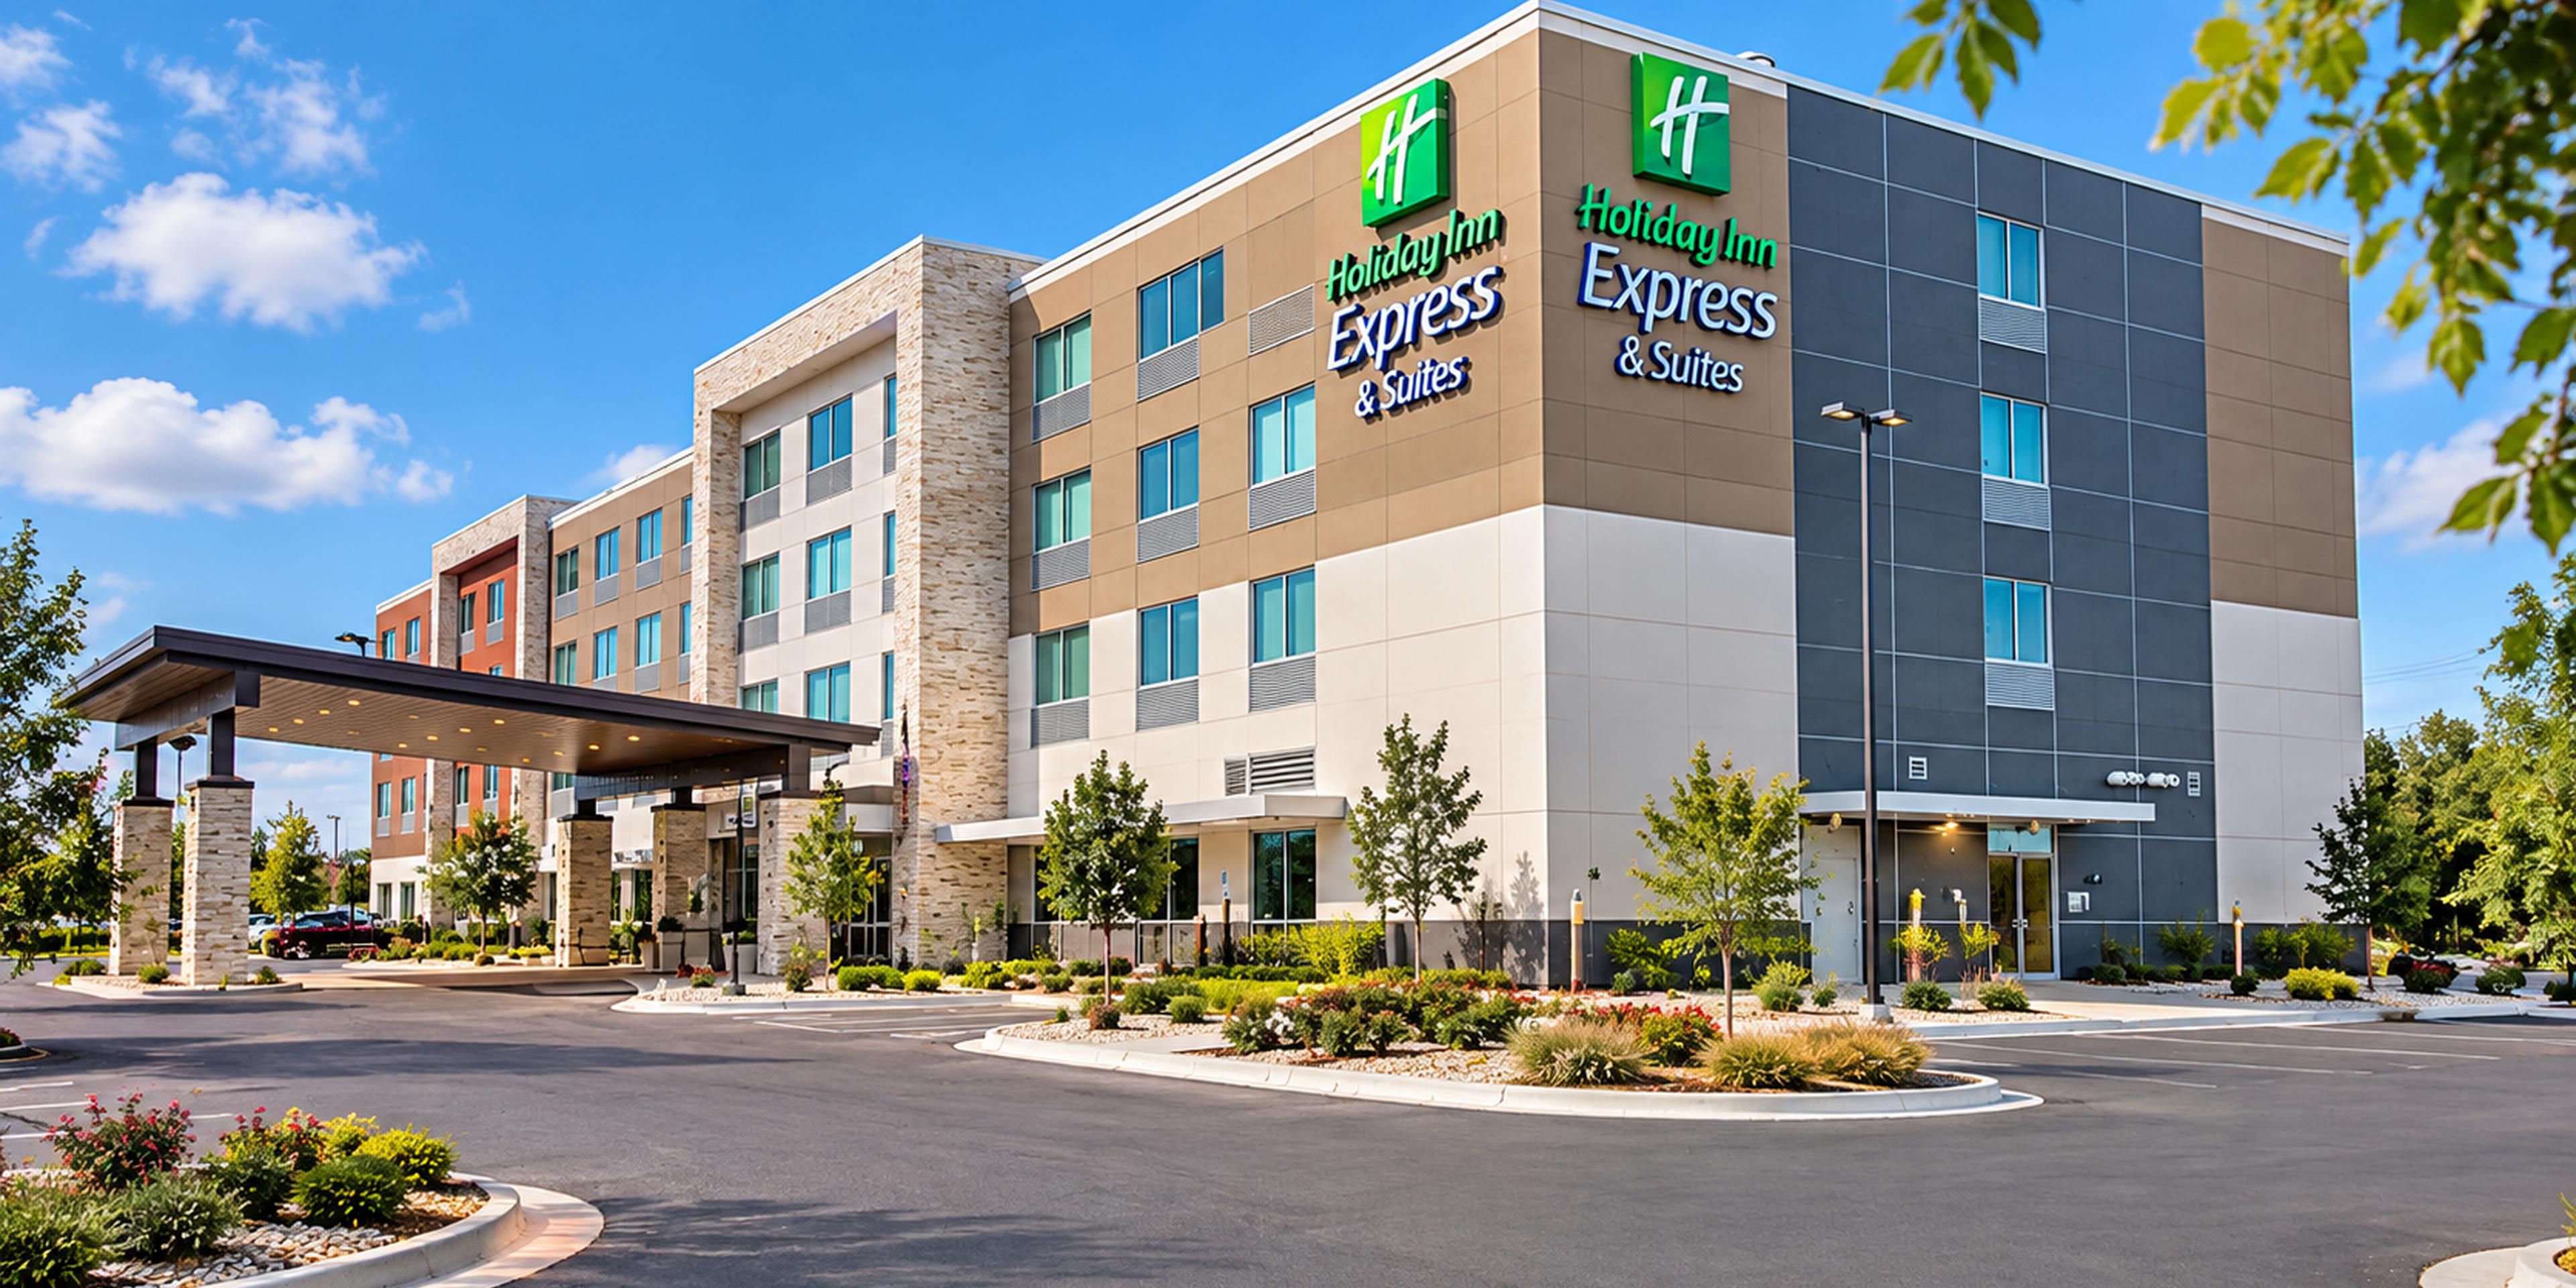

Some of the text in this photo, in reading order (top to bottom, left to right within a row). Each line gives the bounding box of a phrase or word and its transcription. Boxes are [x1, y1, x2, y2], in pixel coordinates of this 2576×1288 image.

[1327, 209, 1501, 302] Holiday Inn
[1578, 182, 1777, 268] Holiday Inn
[1328, 266, 1503, 370] Express
[1578, 242, 1778, 339] Express
[1354, 356, 1469, 417] & Suites
[1615, 335, 1743, 392] & Suites
